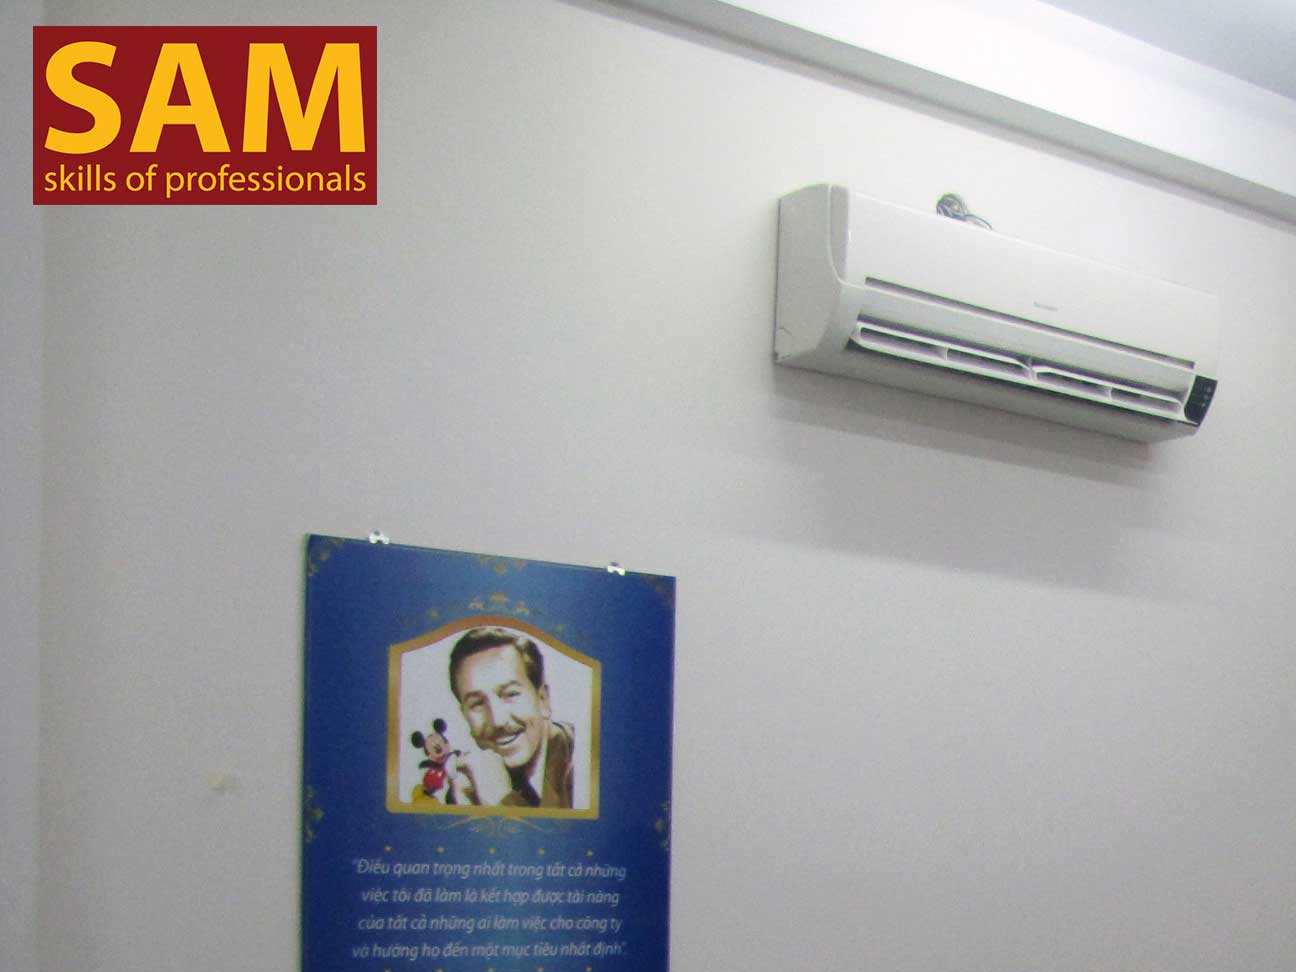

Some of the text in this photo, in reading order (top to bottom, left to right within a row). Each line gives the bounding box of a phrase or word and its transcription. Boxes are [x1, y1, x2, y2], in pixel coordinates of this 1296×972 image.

[393, 863, 430, 877] quan
[507, 864, 543, 880] trong
[435, 887, 462, 902] làm
[477, 915, 490, 930] ai
[549, 915, 574, 930] cho
[610, 916, 624, 933] ty
